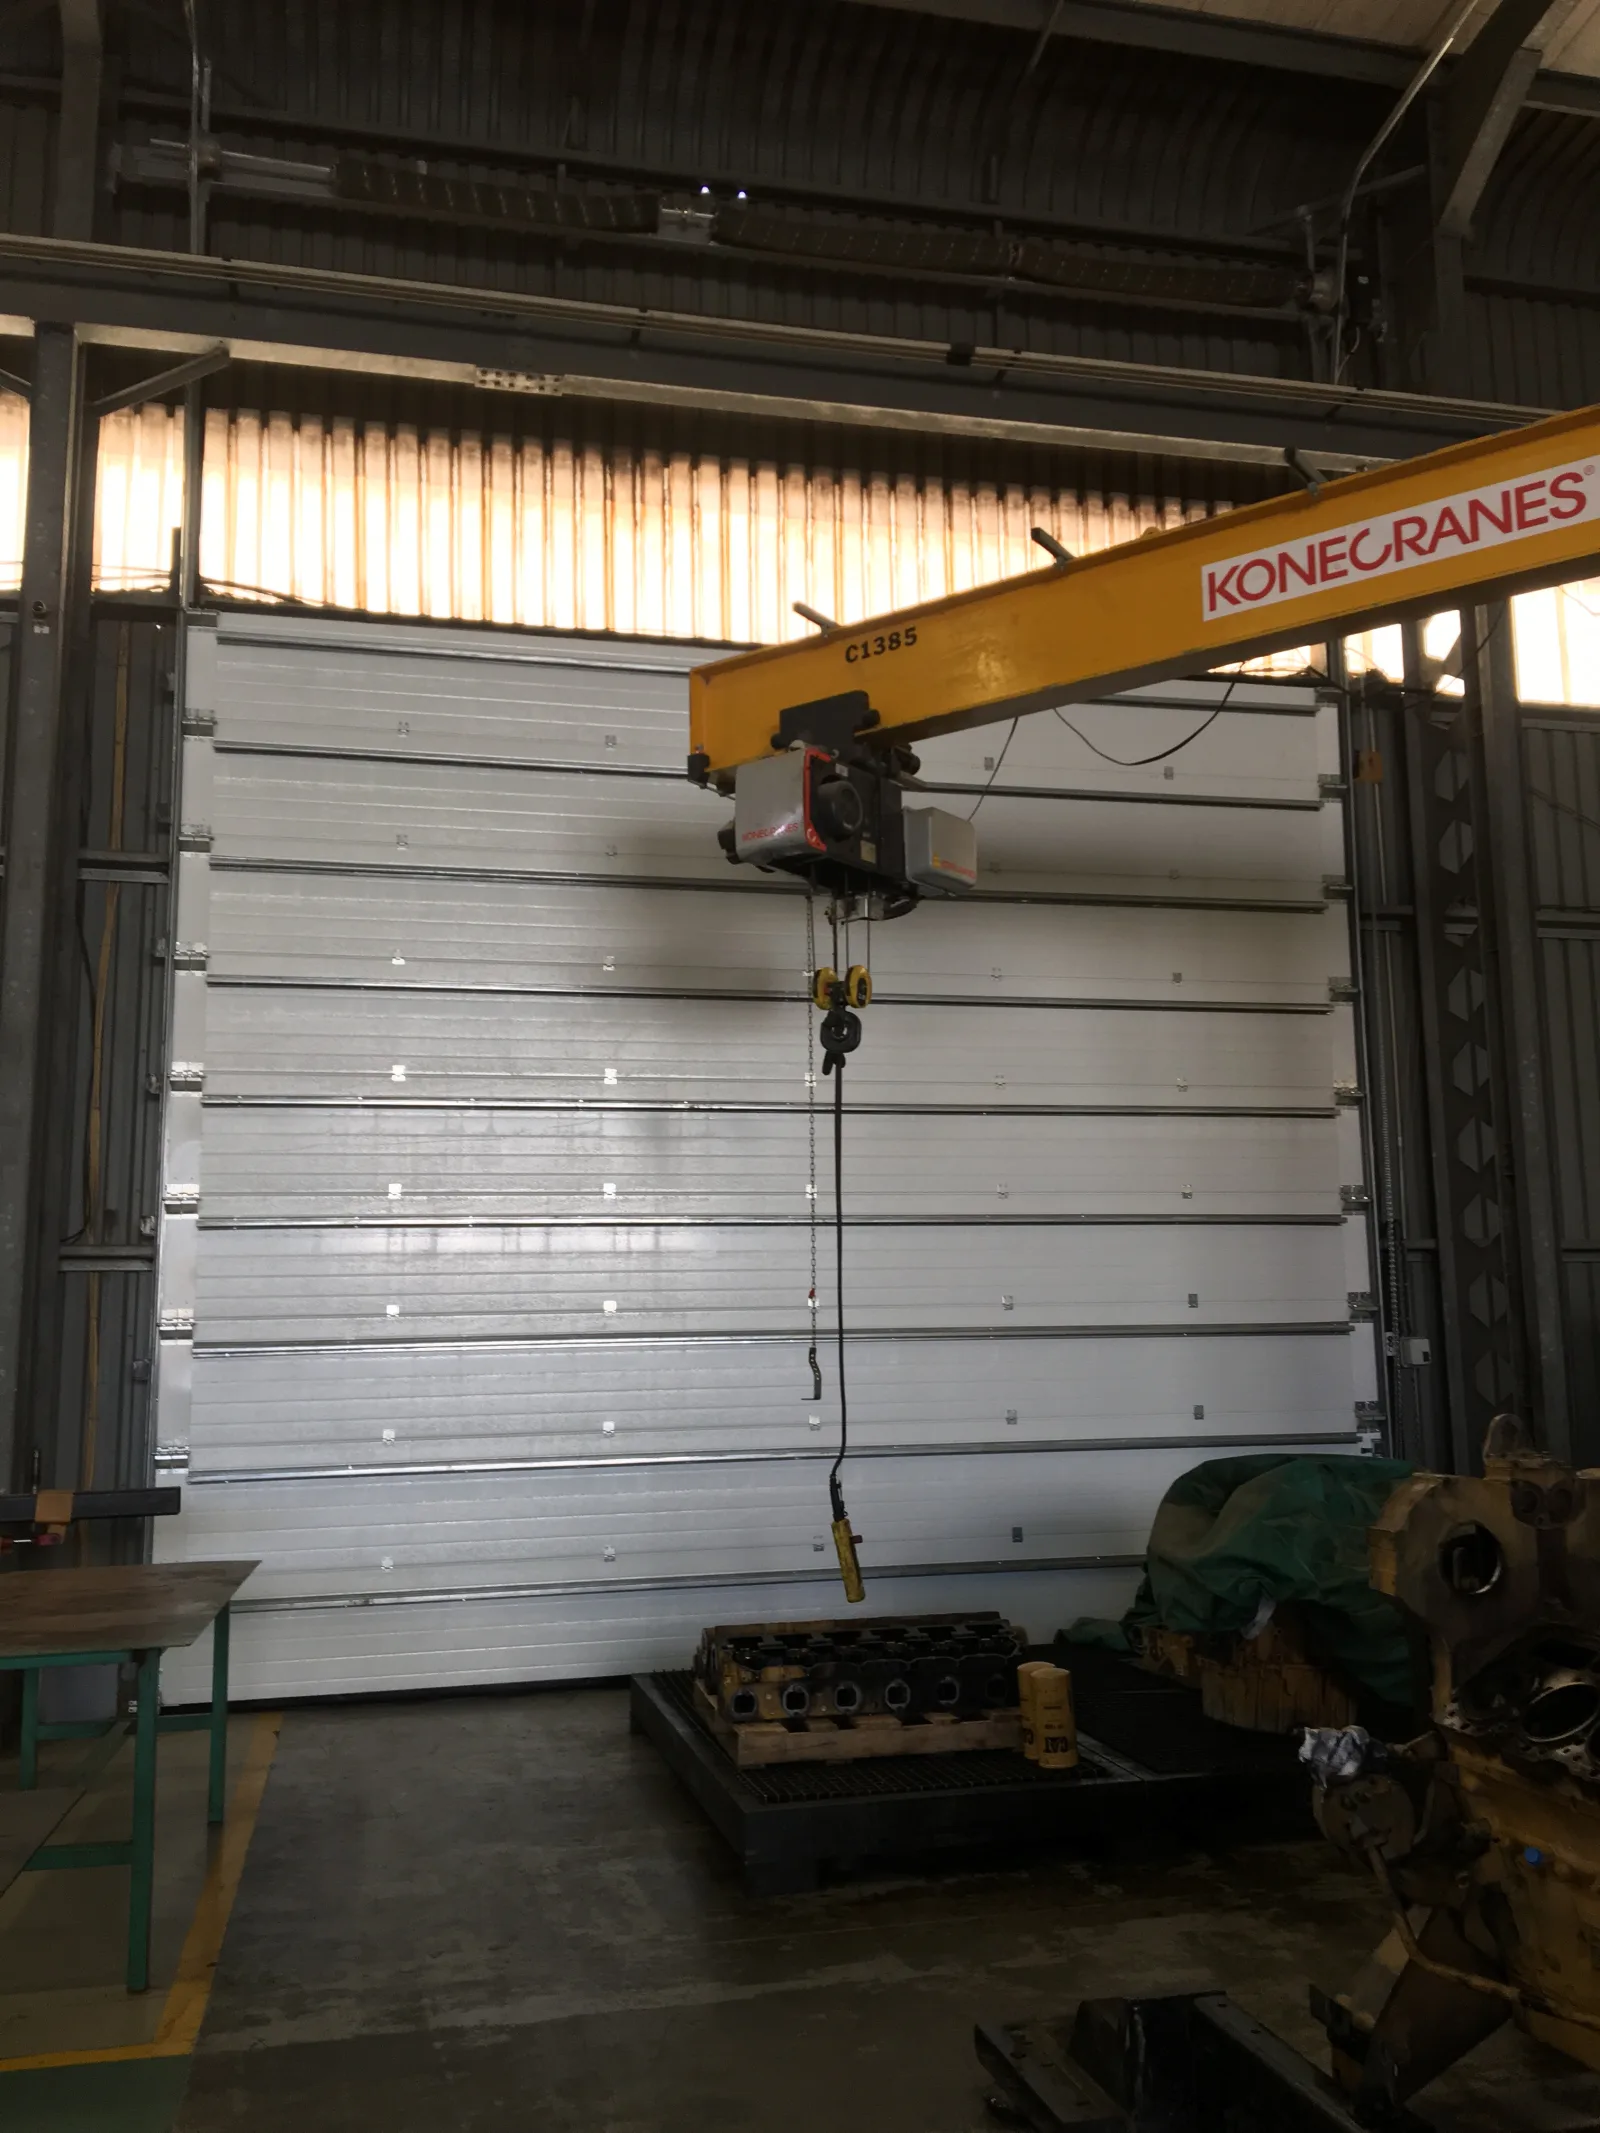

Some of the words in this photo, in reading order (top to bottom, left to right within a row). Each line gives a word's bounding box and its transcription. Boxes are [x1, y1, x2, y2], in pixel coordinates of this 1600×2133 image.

[1208, 472, 1587, 611] KONECRANES
[845, 627, 918, 662] C1385
[1043, 1736, 1068, 1753] CAT
